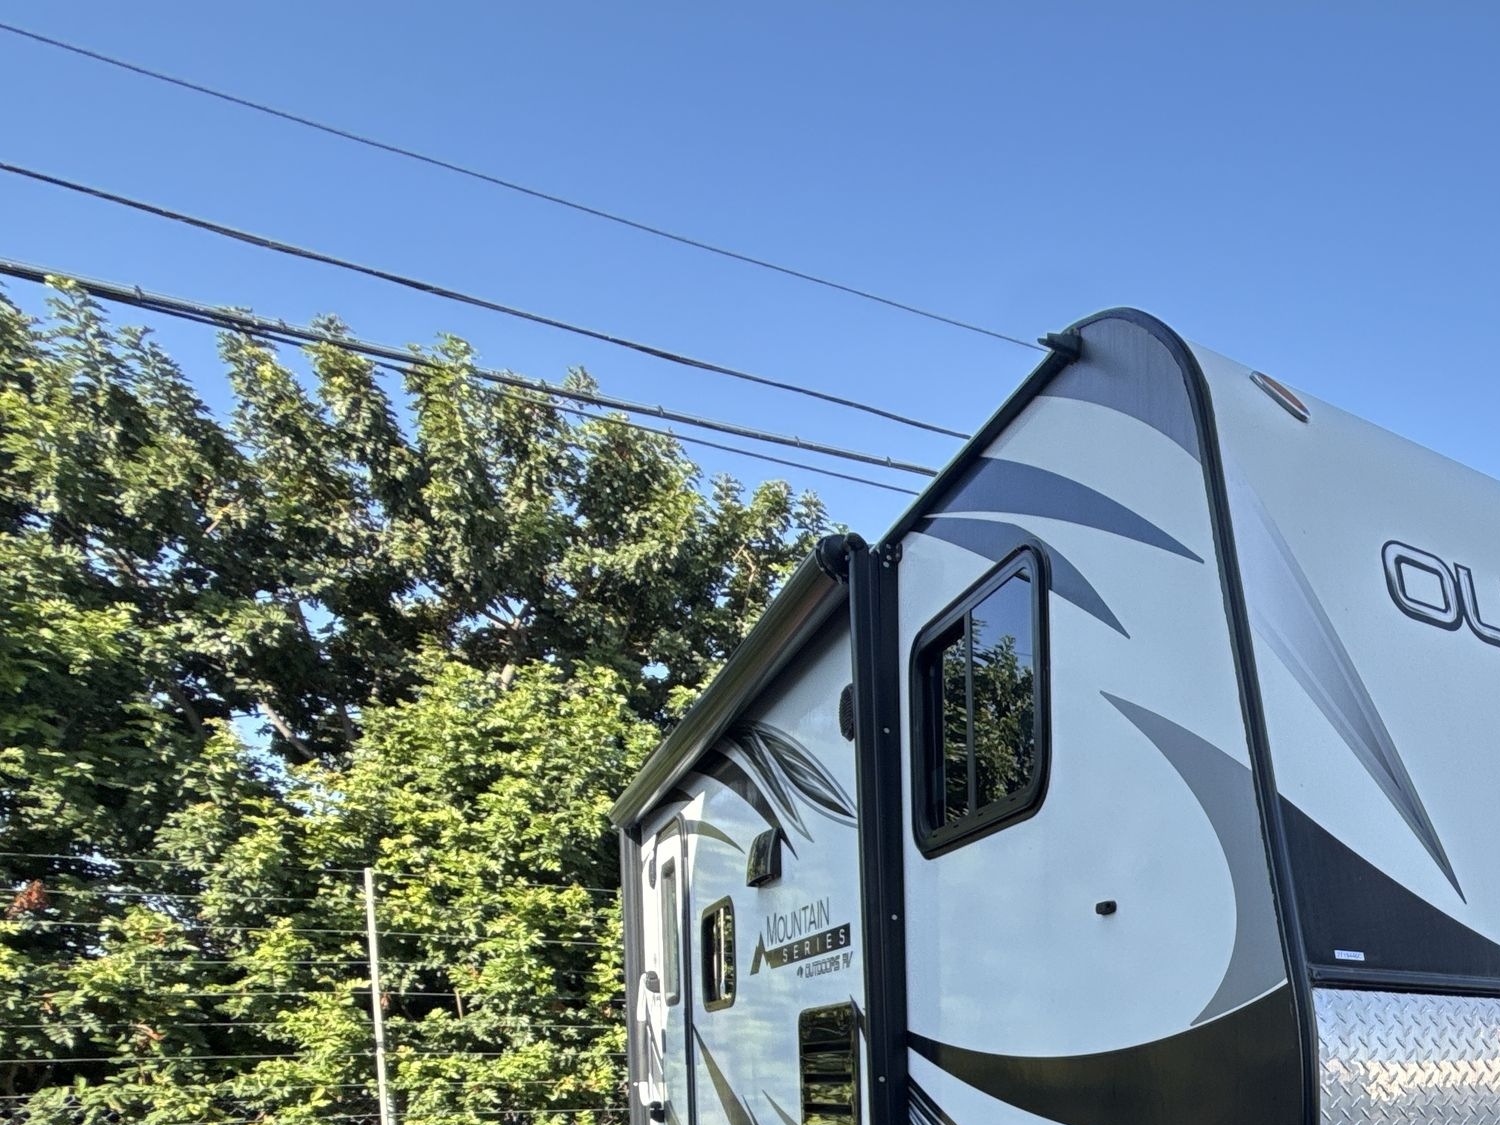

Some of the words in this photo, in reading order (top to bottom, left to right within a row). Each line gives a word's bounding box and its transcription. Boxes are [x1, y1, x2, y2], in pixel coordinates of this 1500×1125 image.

[766, 897, 830, 947] MOUNTAIN
[782, 928, 846, 963] SERIES
[805, 955, 841, 978] OUTDOORS
[842, 951, 853, 970] RV
